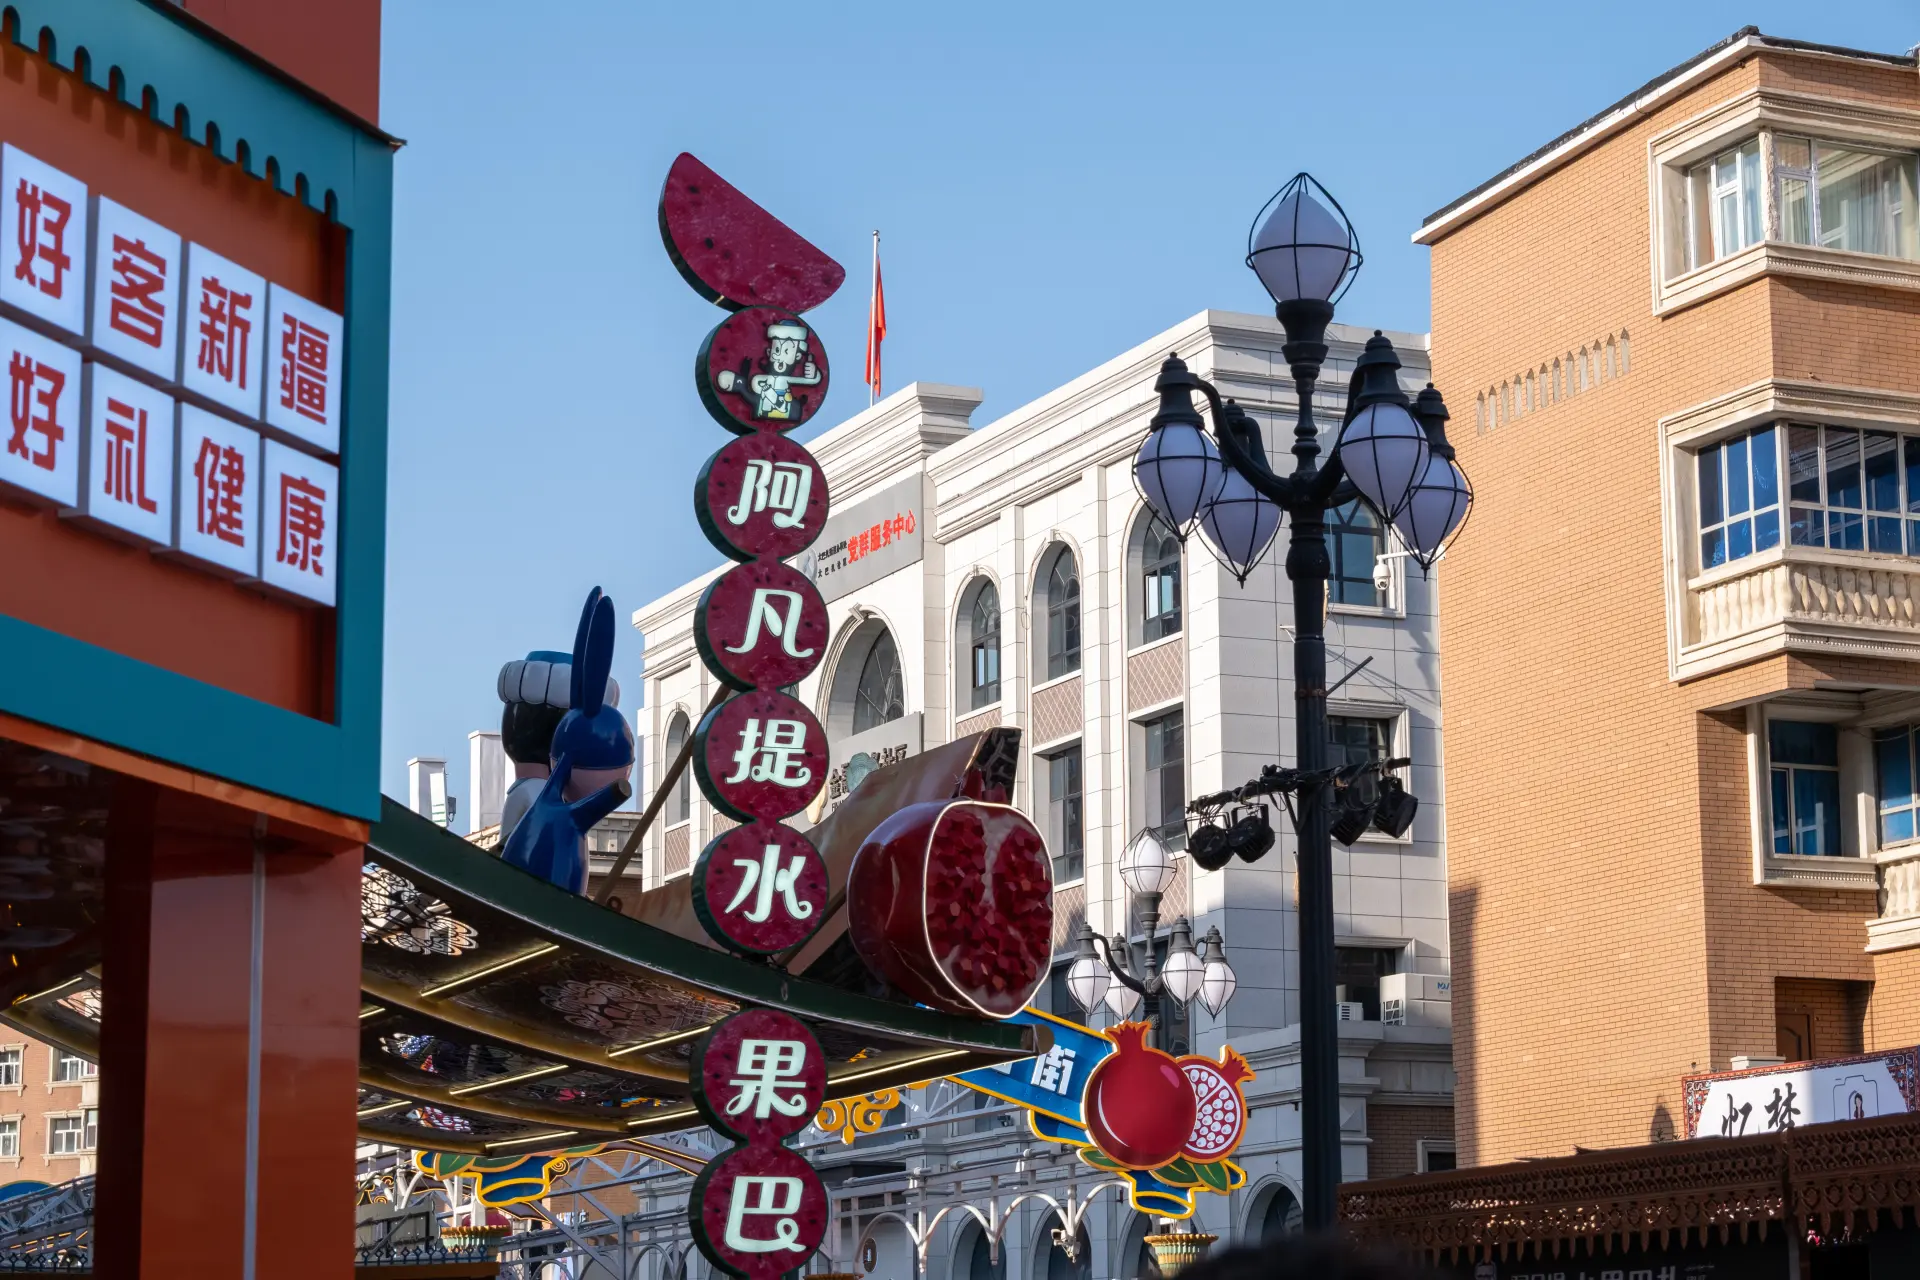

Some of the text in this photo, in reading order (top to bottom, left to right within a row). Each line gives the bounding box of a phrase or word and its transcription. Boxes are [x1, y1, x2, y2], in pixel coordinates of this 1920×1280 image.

[16, 178, 329, 425] 好客新疆
[8, 350, 326, 576] 好礼健康
[847, 509, 917, 564] 党群服务中心
[724, 459, 814, 1253] 阿凡提水果巴
